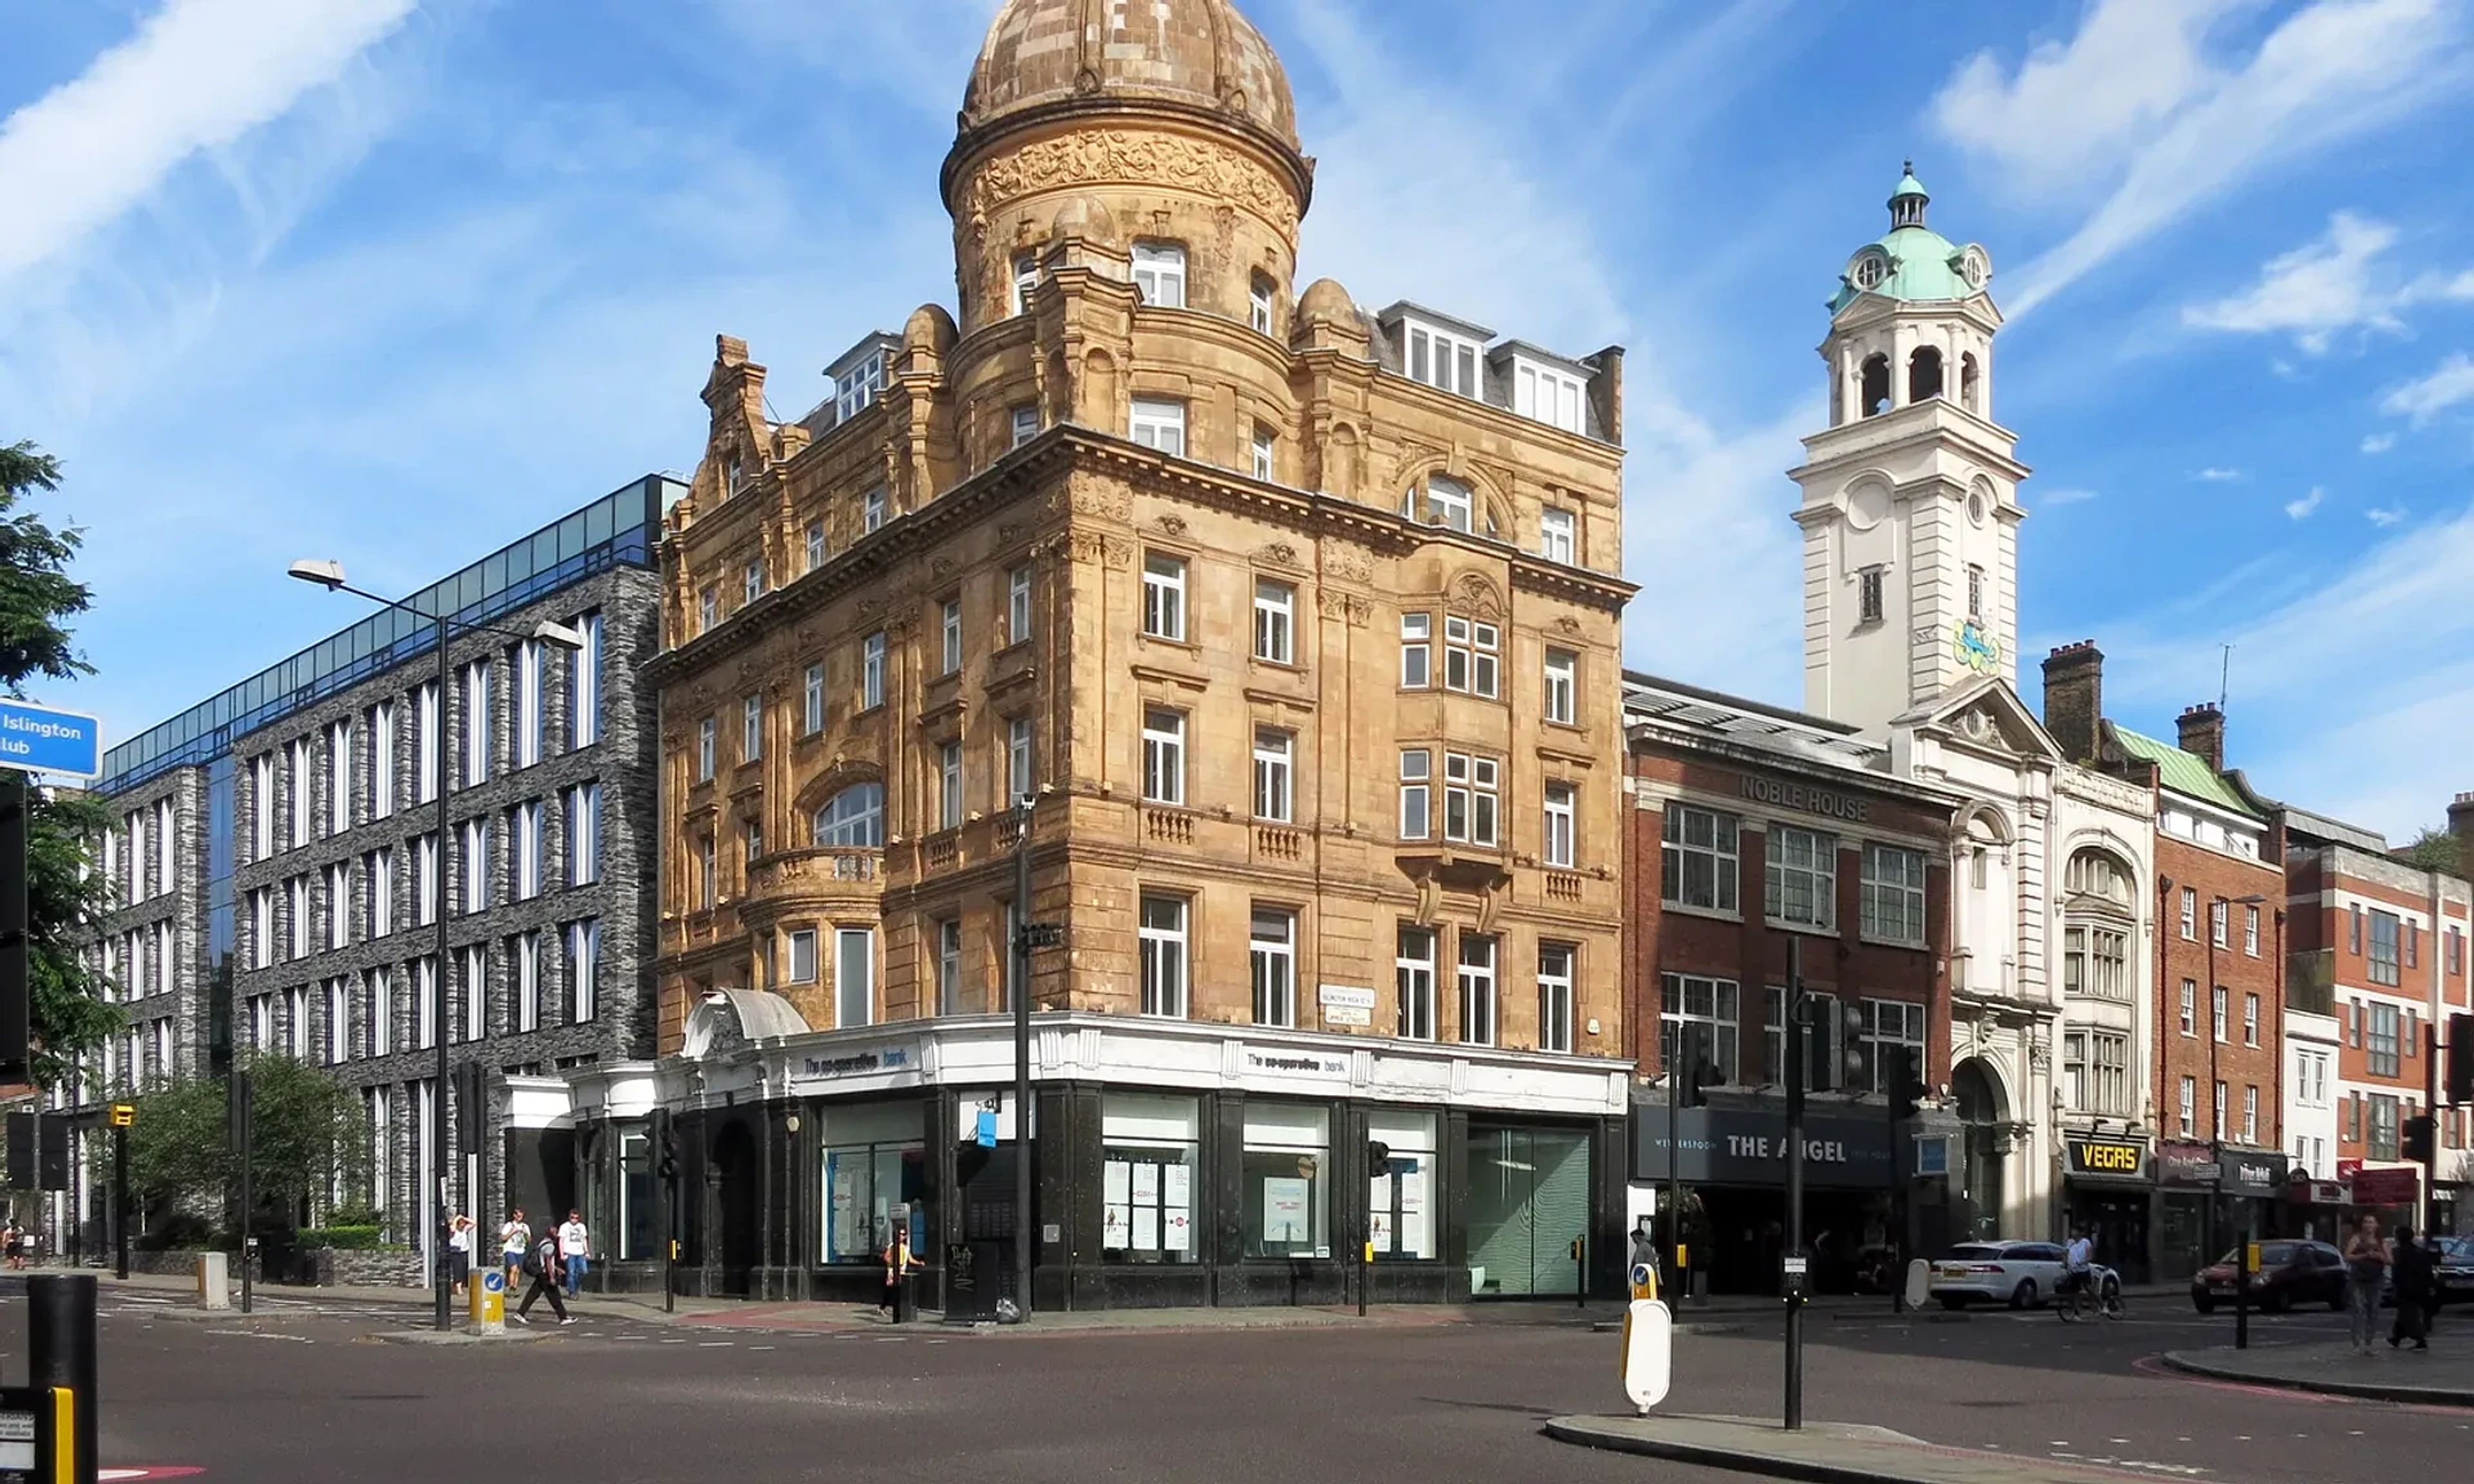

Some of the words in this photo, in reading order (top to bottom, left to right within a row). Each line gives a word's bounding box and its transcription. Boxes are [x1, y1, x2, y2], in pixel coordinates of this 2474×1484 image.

[3, 714, 82, 741] Islington
[0, 736, 30, 755] lub
[1741, 775, 1802, 808] NOBLE
[1807, 788, 1868, 823] HOUSE
[805, 1056, 819, 1073] The
[883, 1049, 908, 1067] bank
[1248, 1053, 1263, 1066] The
[1325, 1059, 1346, 1073] bank
[1727, 1134, 1768, 1159] THE
[2081, 1143, 2137, 1170] VEGAS
